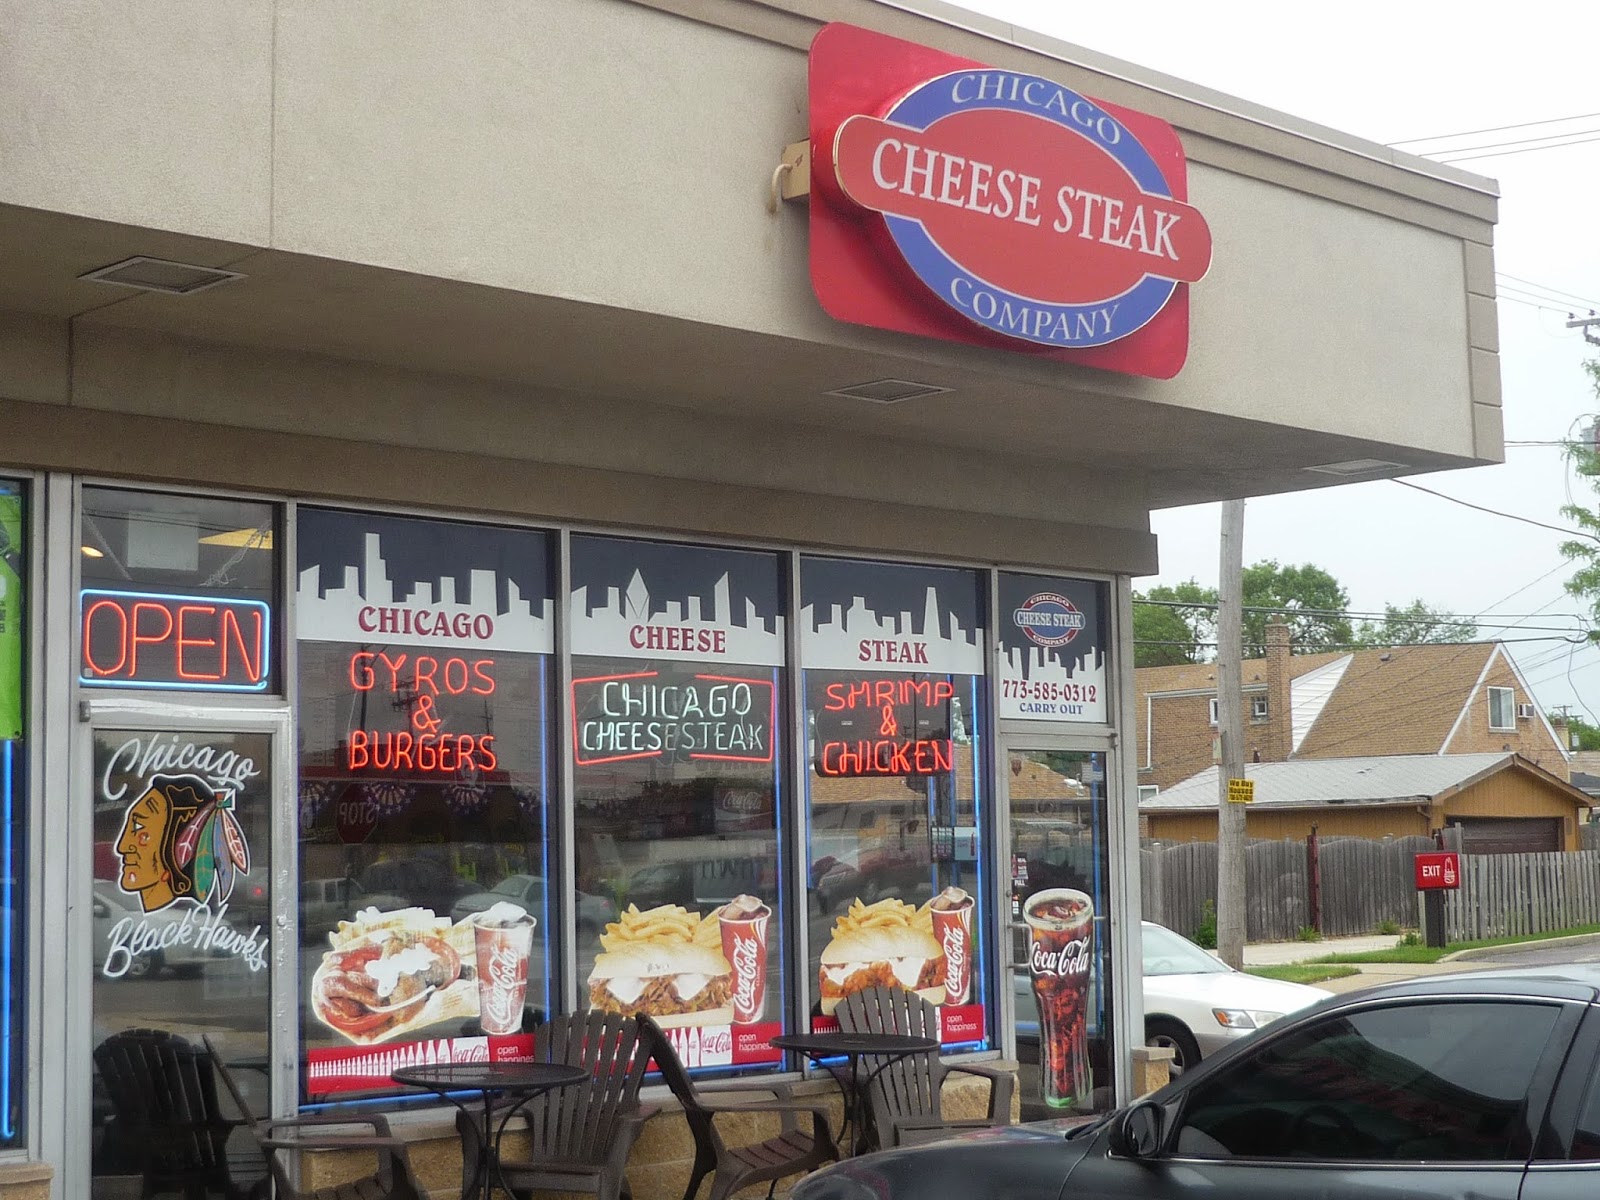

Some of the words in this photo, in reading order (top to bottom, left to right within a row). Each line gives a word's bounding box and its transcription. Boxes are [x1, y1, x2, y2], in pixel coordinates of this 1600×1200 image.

[952, 73, 1121, 146] CHICAGO
[872, 138, 1041, 227] CHEESE
[1053, 185, 1182, 261] STEAK
[950, 277, 1120, 340] COMPANY
[1030, 594, 1070, 607] CHICAGO
[358, 606, 494, 640] CHICAGO
[1017, 611, 1051, 626] CHEESE
[1053, 613, 1082, 628] STEAK
[85, 600, 262, 682] OPEN
[629, 624, 726, 653] CHEESE
[858, 639, 929, 664] STEAK
[1032, 634, 1070, 645] COMPANY
[350, 652, 497, 696] GYROS
[603, 682, 752, 719] CHICAGO
[824, 680, 954, 711] SHRIMP
[1003, 679, 1097, 702] 773-585-0312
[412, 694, 441, 734] &
[880, 704, 898, 736] &
[1019, 702, 1056, 714] CARRY
[1060, 703, 1083, 715] OUT
[349, 729, 498, 771] BURGERS
[582, 721, 764, 752] CHEESESTEAK
[103, 732, 262, 801] Chicago
[821, 738, 954, 775] CHICKEN
[1241, 780, 1254, 788] Buy
[1422, 865, 1441, 877] EXIT
[943, 921, 964, 997] Coca-Cola
[1030, 934, 1091, 976] Coca-Cola
[486, 943, 518, 1025] Coca-Cola
[733, 931, 758, 1014] Coca-Cola
[947, 1015, 962, 1024] open
[947, 1023, 977, 1032] happiness
[497, 1045, 519, 1055] open
[739, 1033, 756, 1043] open
